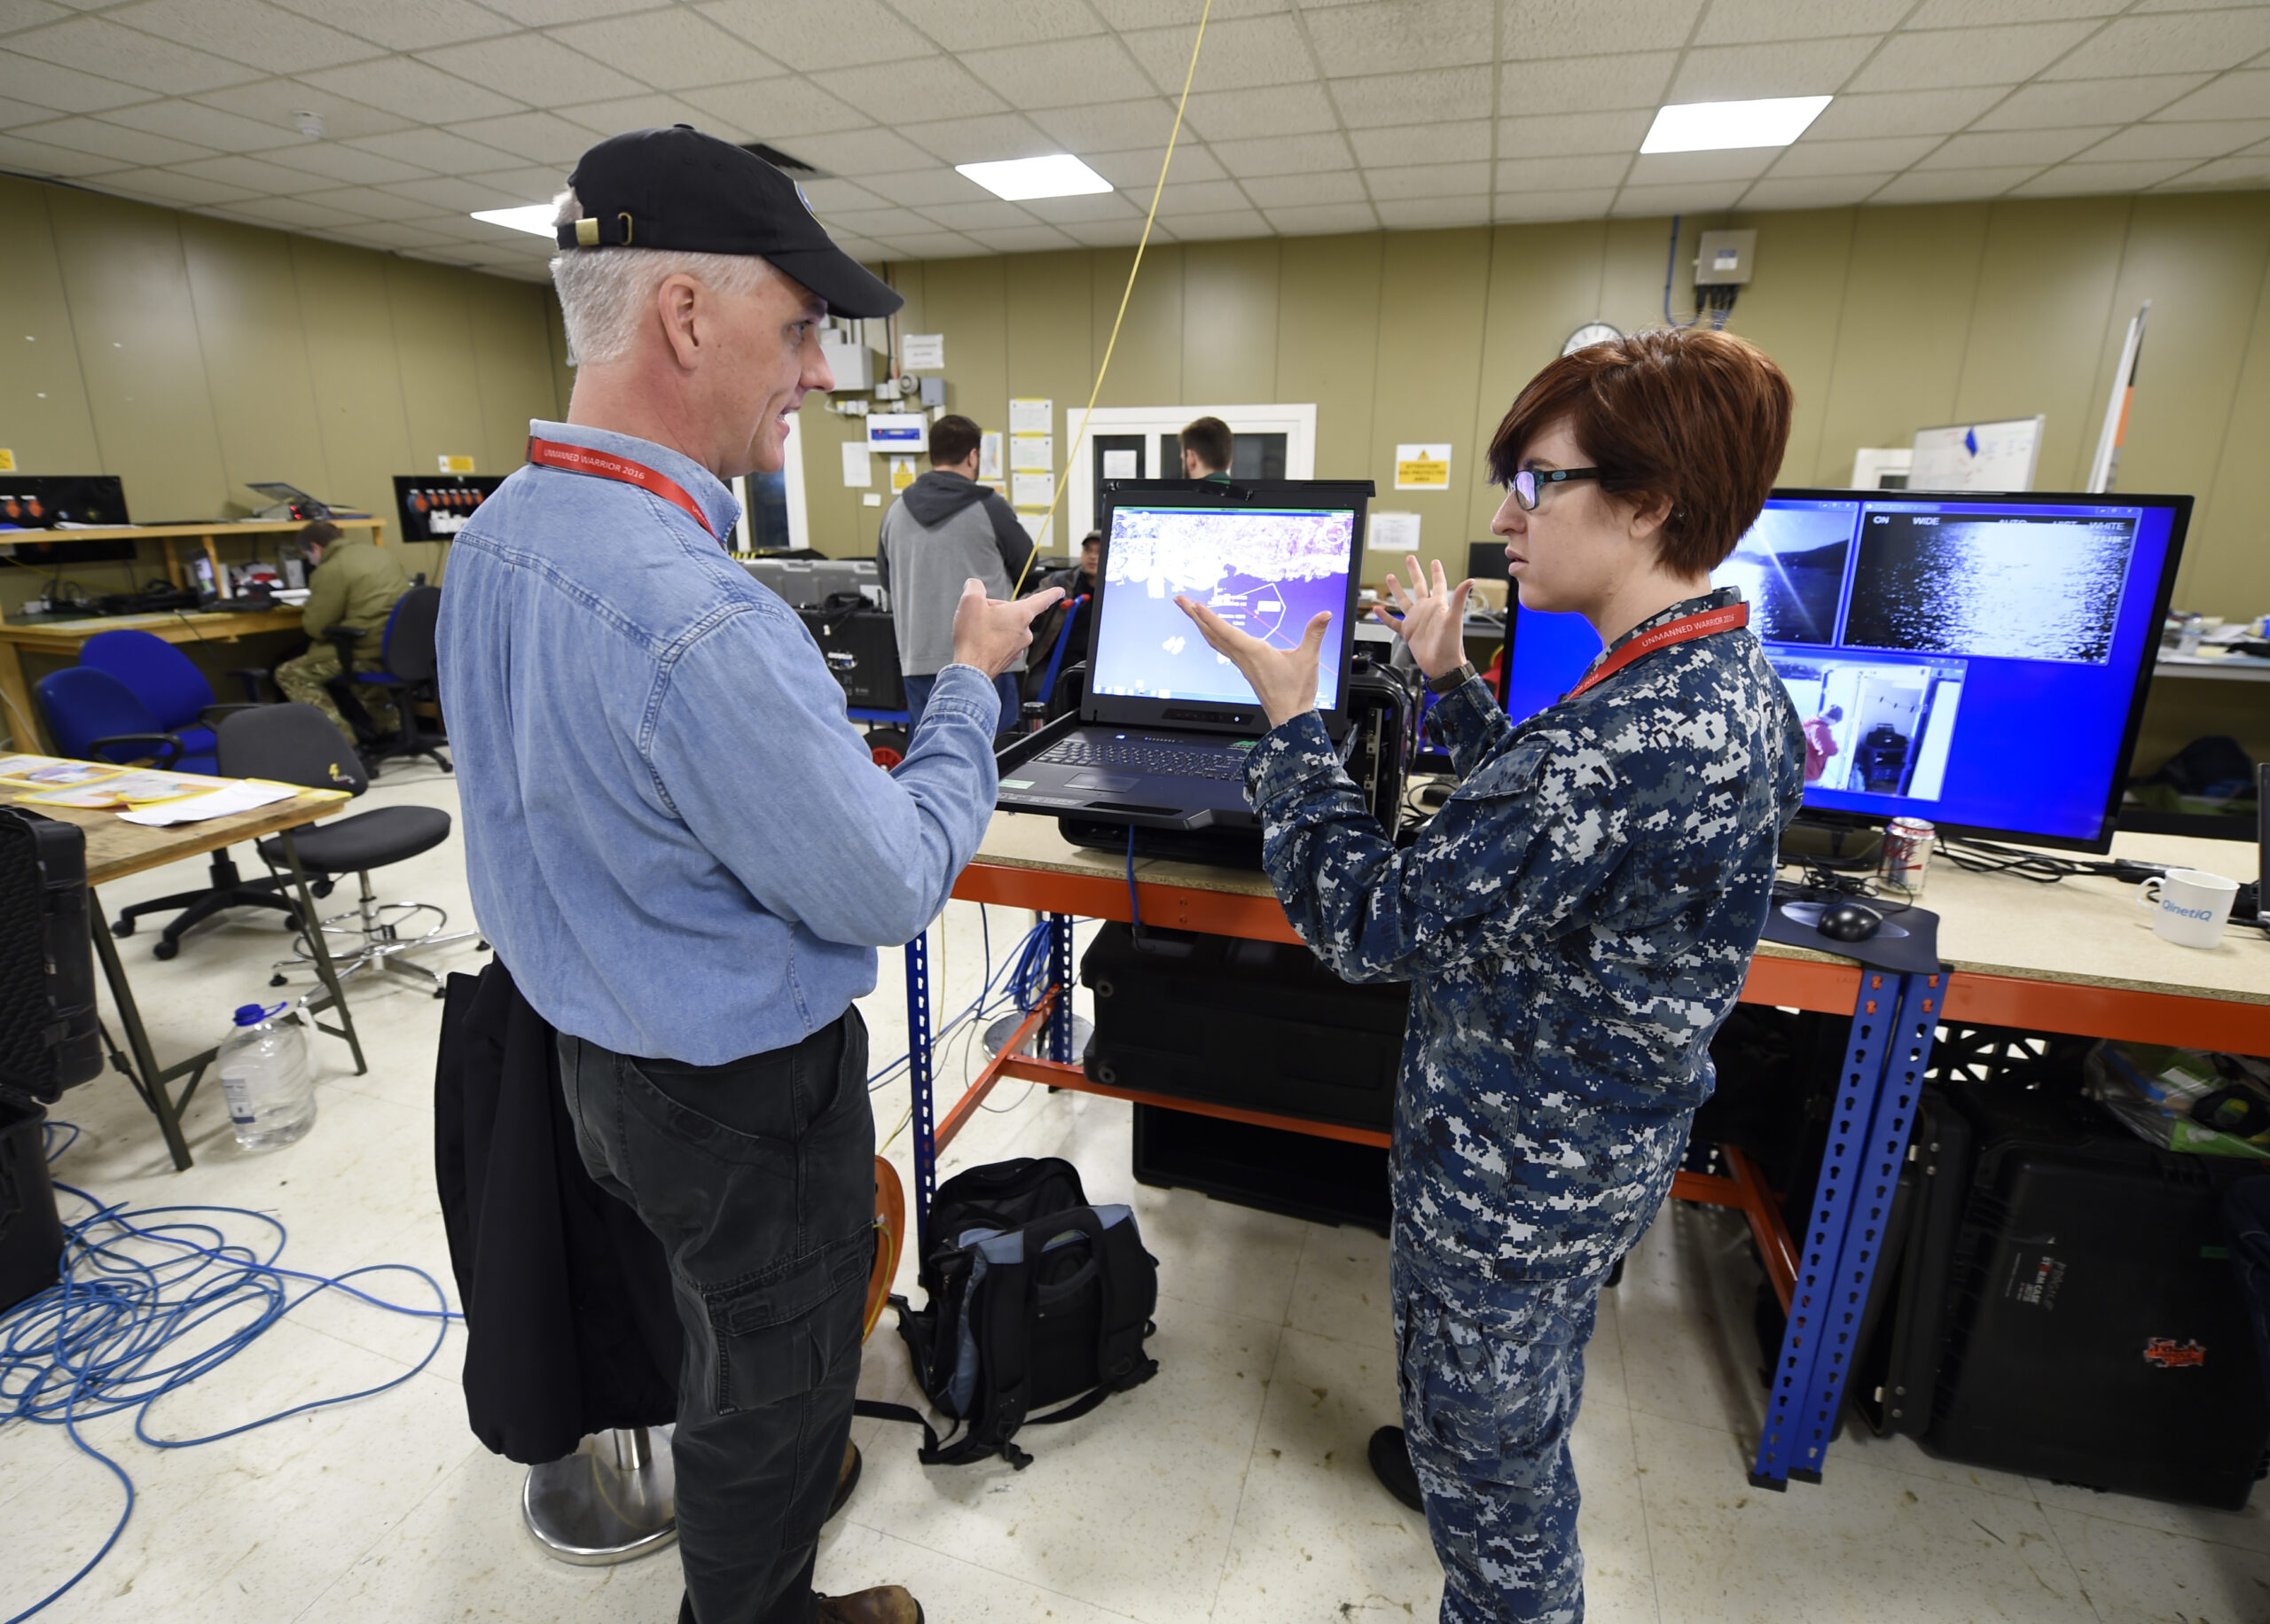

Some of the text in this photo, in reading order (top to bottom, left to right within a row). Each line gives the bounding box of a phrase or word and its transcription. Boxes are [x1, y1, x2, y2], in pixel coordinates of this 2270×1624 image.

[543, 449, 646, 480] UNMANNED WARRIOR 2016
[1873, 516, 1890, 525] ON
[1912, 517, 1941, 526] WIDE
[2088, 521, 2125, 531] WHITE
[1641, 624, 1693, 647] UNMANNED
[1694, 616, 1723, 630] WARRIOR
[2162, 900, 2212, 922] QinetiQ
